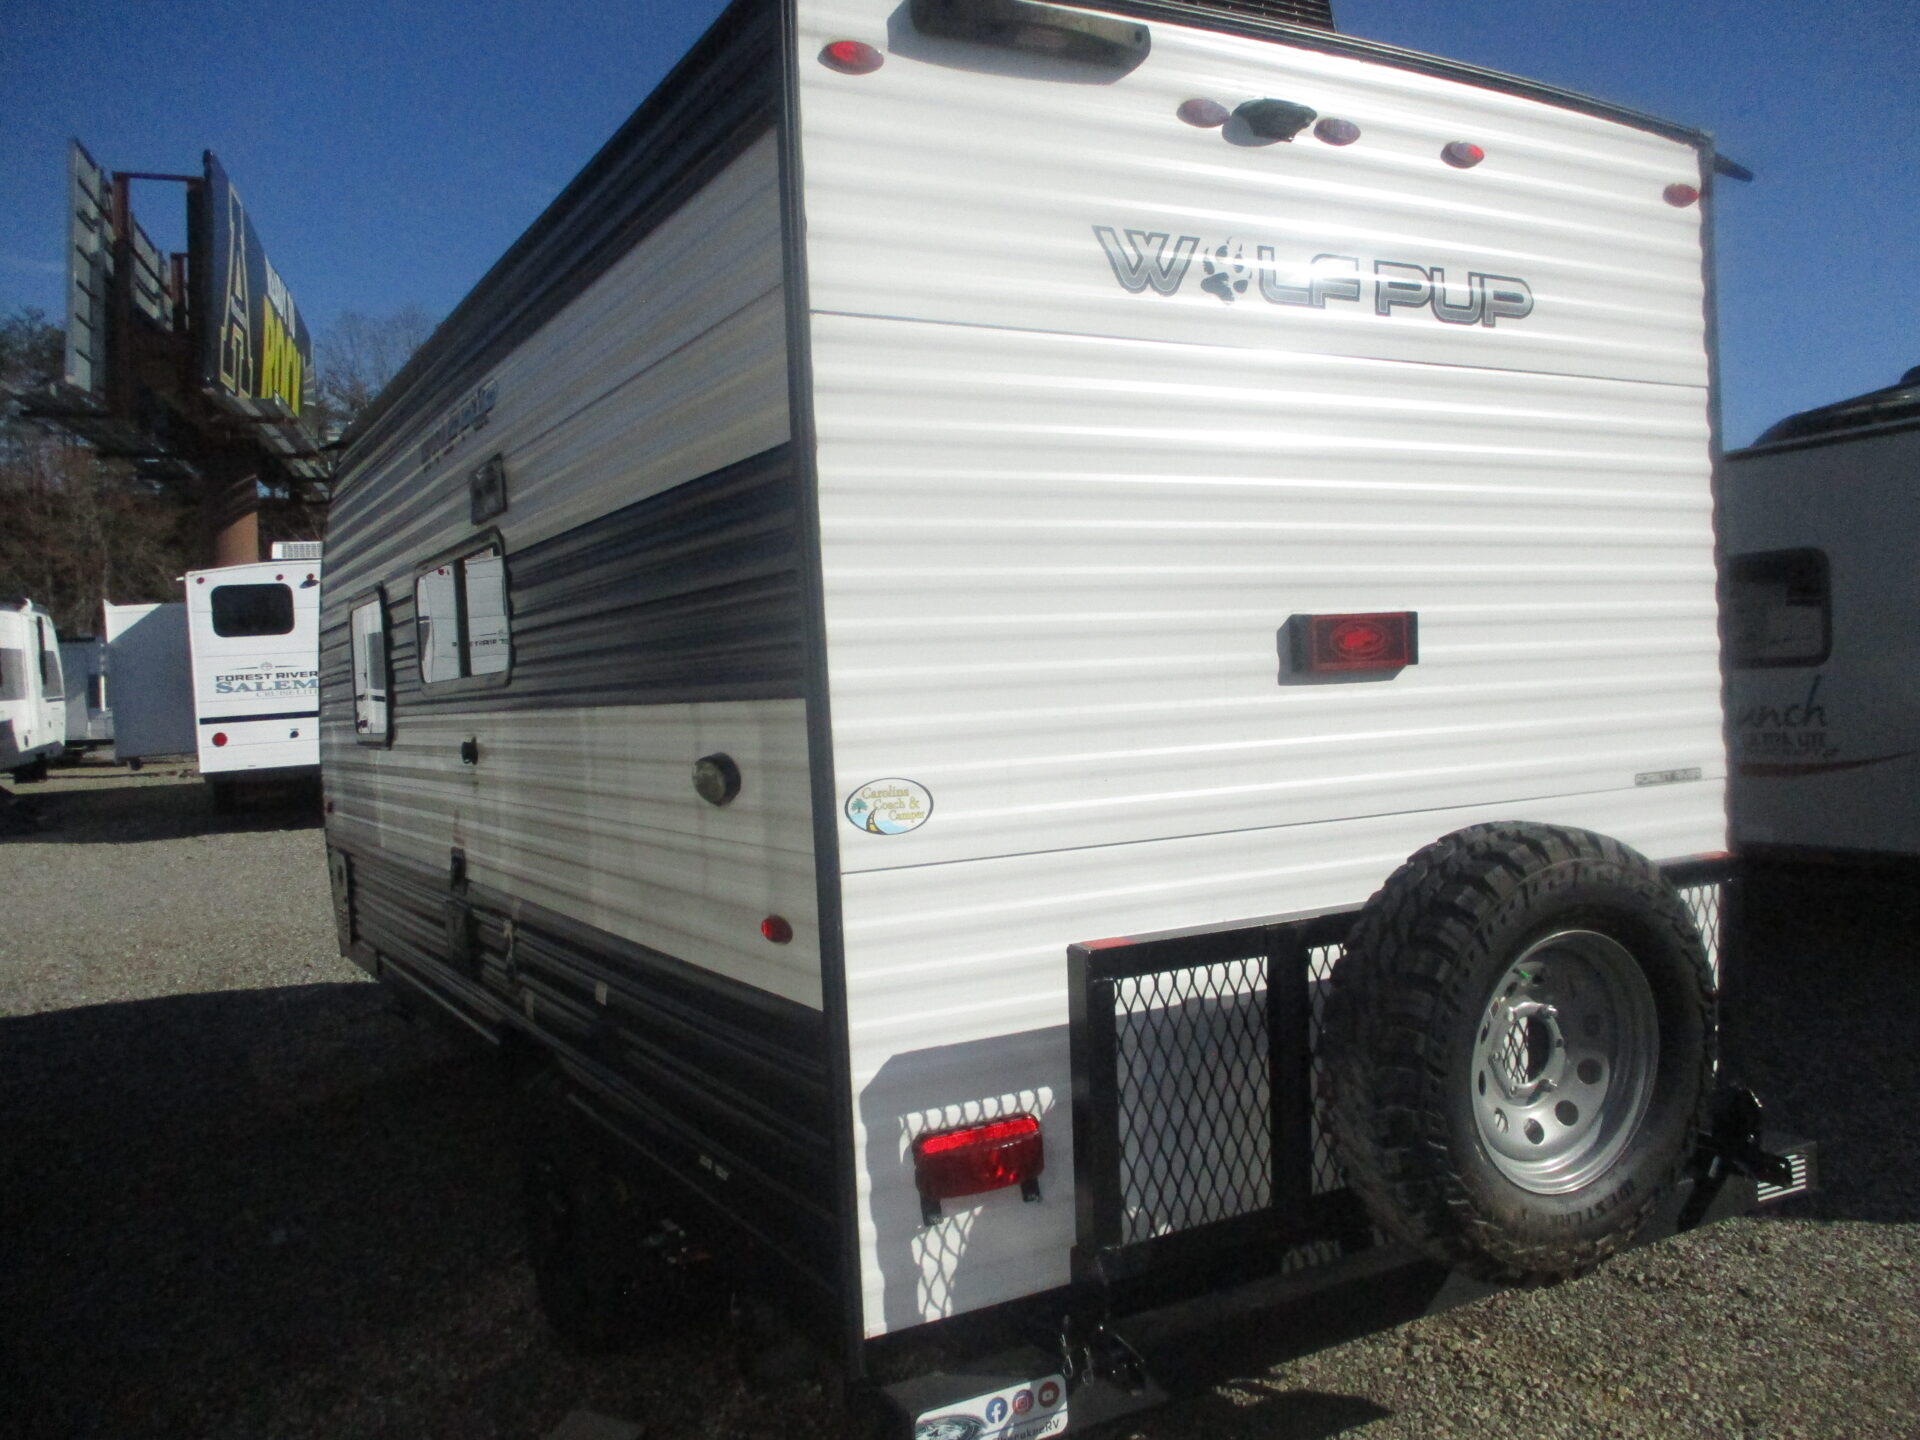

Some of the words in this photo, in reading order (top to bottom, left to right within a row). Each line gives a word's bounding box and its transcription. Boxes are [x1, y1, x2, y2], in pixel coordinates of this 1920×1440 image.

[1374, 259, 1535, 329] PUP
[216, 673, 272, 682] FOREST
[276, 671, 318, 679] RIVER
[216, 680, 318, 693] SALEM
[861, 785, 910, 799] Carolina
[873, 798, 905, 810] Coach
[909, 796, 921, 809] &
[888, 810, 926, 824] Camper
